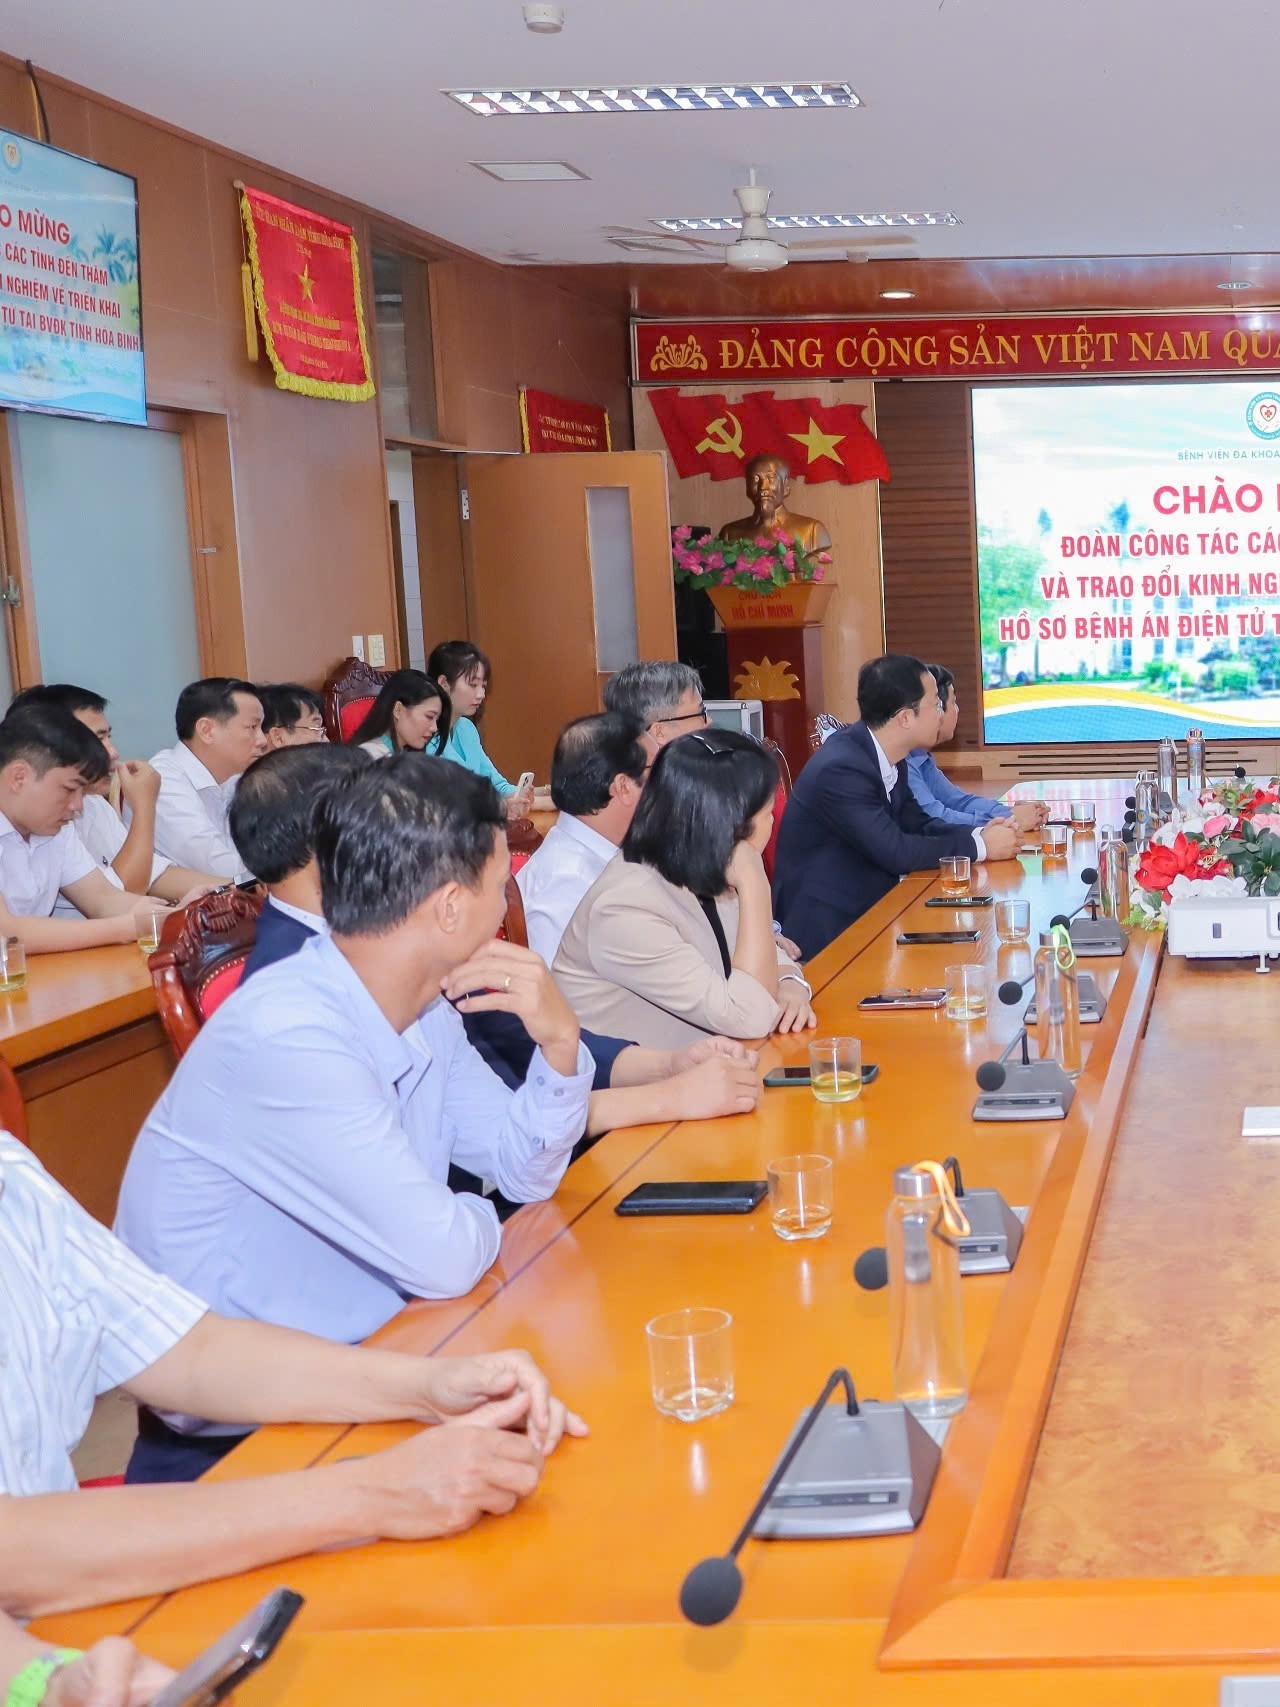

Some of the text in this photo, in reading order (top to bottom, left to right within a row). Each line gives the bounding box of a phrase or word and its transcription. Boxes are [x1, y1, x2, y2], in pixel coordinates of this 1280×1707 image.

[18, 208, 70, 245] MỪNG
[39, 315, 66, 336] BVĐK
[99, 299, 121, 318] KHAI
[718, 327, 824, 369] ĐẢNG
[835, 327, 939, 375] CỘNG
[949, 323, 1021, 366] SẢN
[1032, 324, 1119, 370] VIỆT
[1127, 330, 1212, 362] NAM
[1233, 450, 1248, 459] ĐA
[1251, 449, 1280, 459] KHOA
[1153, 475, 1263, 514] CHÀO
[1060, 530, 1120, 558] ĐOÀN
[1129, 528, 1189, 557] CÔNG
[1197, 527, 1239, 555] TÁC
[1040, 571, 1070, 599] VÀ
[1077, 575, 1134, 598] TRAO
[1142, 564, 1180, 597] ĐỔI
[1189, 573, 1240, 596] KINH
[1000, 610, 1031, 641] HỒ
[1038, 614, 1067, 640] SƠ
[1075, 611, 1133, 644] BỆNH
[1141, 610, 1170, 638] ÁN
[1178, 609, 1229, 641] ĐIỆN
[1236, 606, 1265, 635] TỬ
